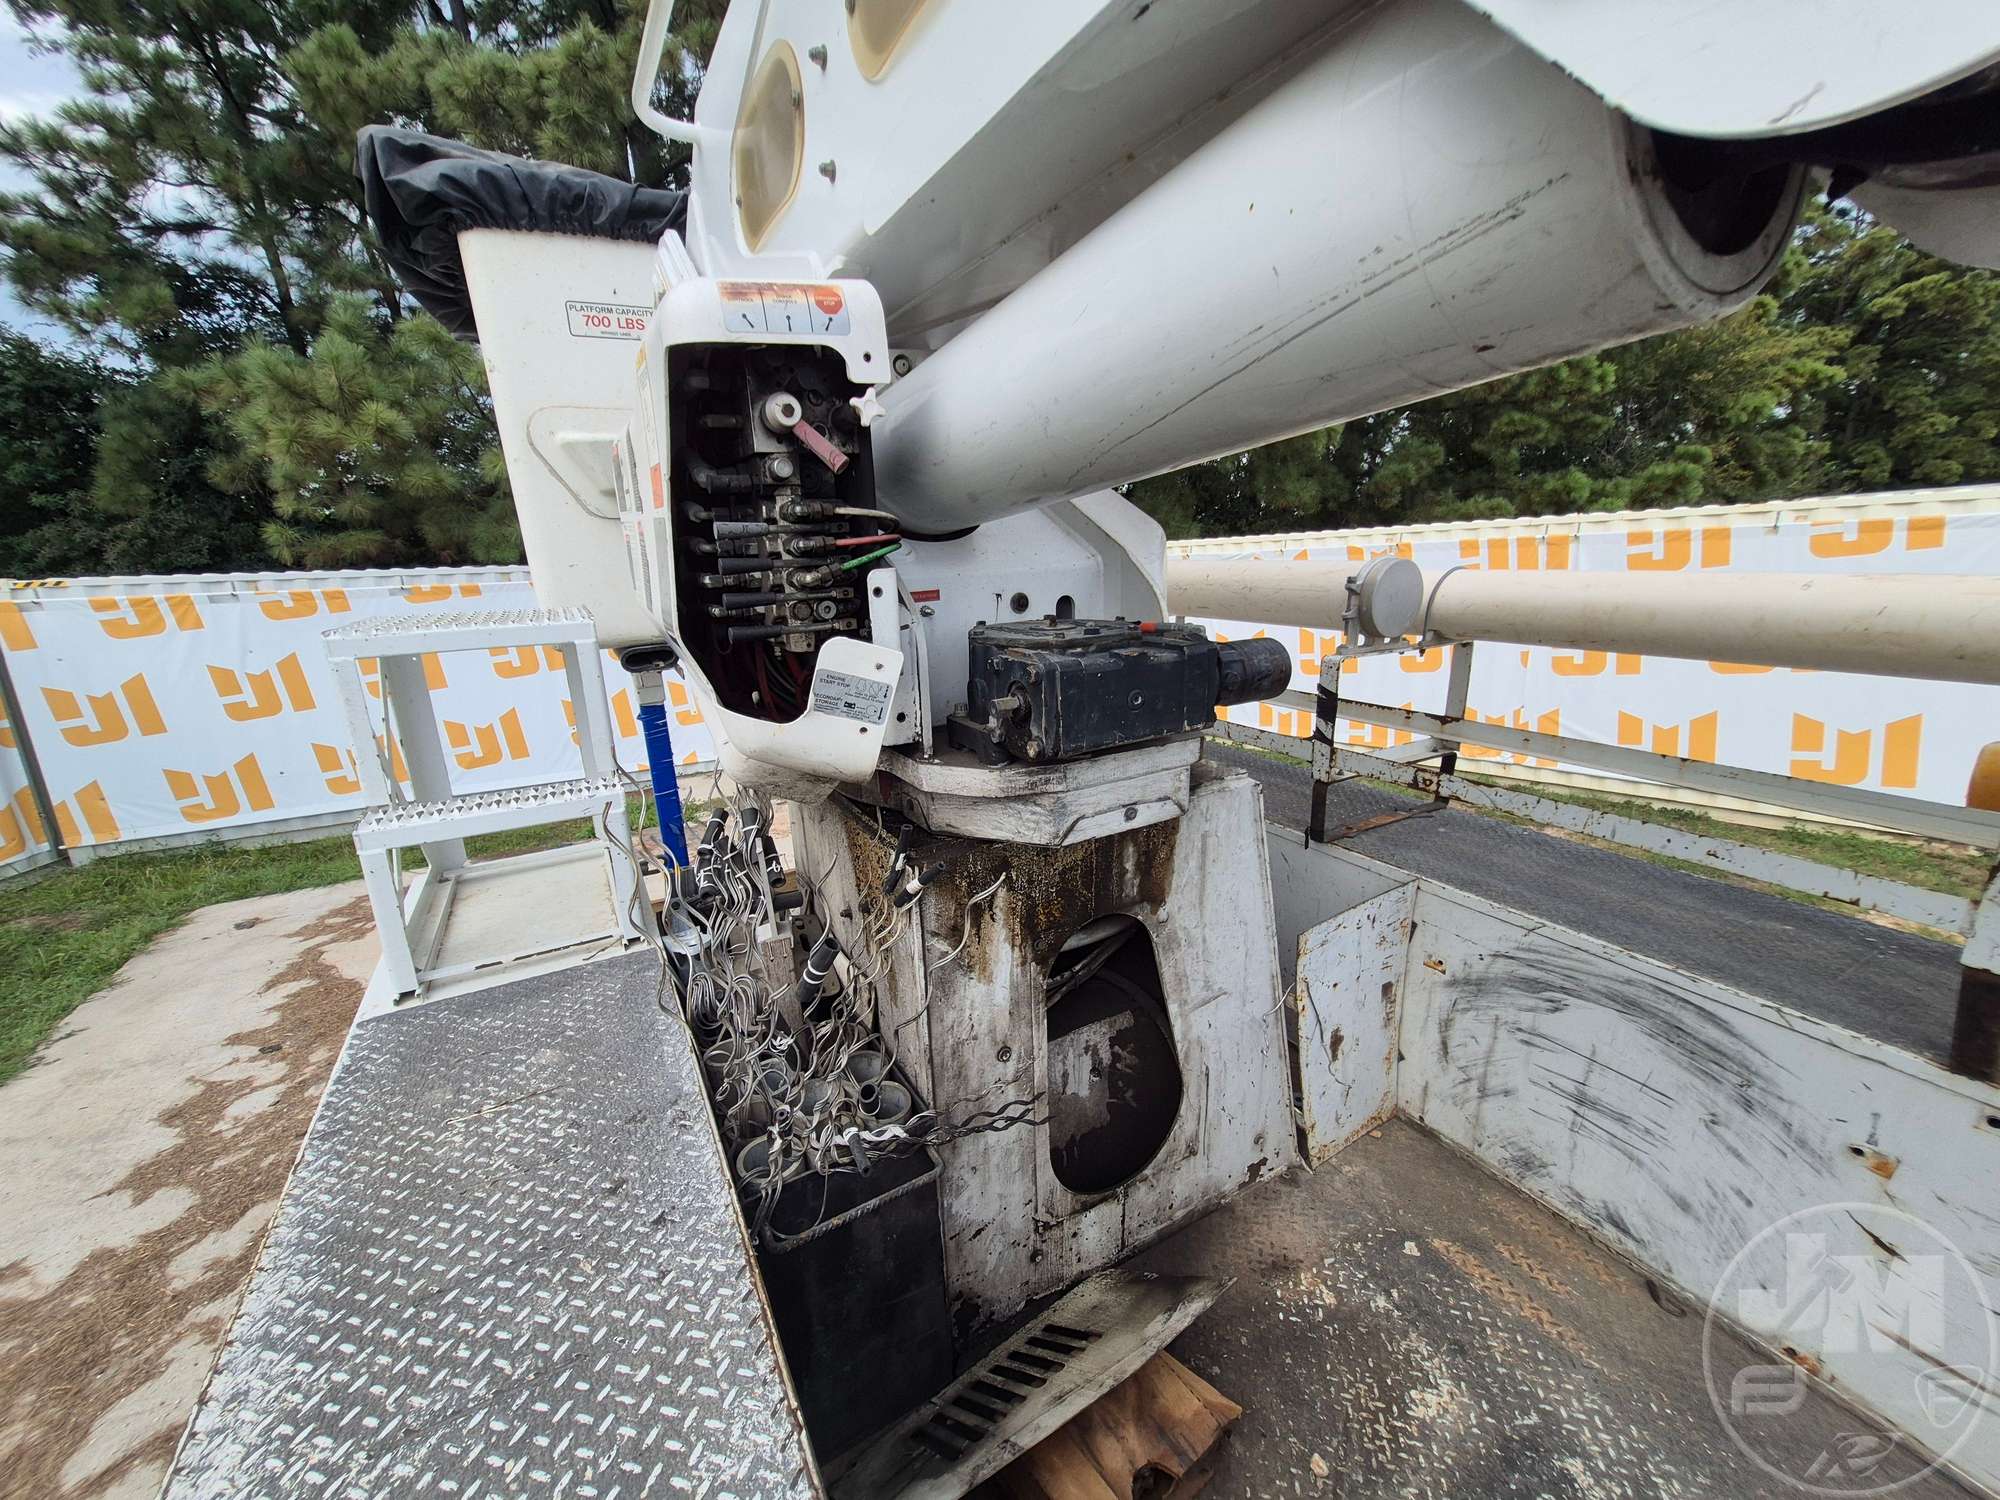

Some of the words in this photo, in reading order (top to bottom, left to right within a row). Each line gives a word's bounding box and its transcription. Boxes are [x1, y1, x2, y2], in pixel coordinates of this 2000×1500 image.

[568, 303, 614, 315] PLATFORM
[615, 307, 654, 318] CAPACITY
[582, 314, 611, 329] 700
[616, 317, 646, 331] LBS
